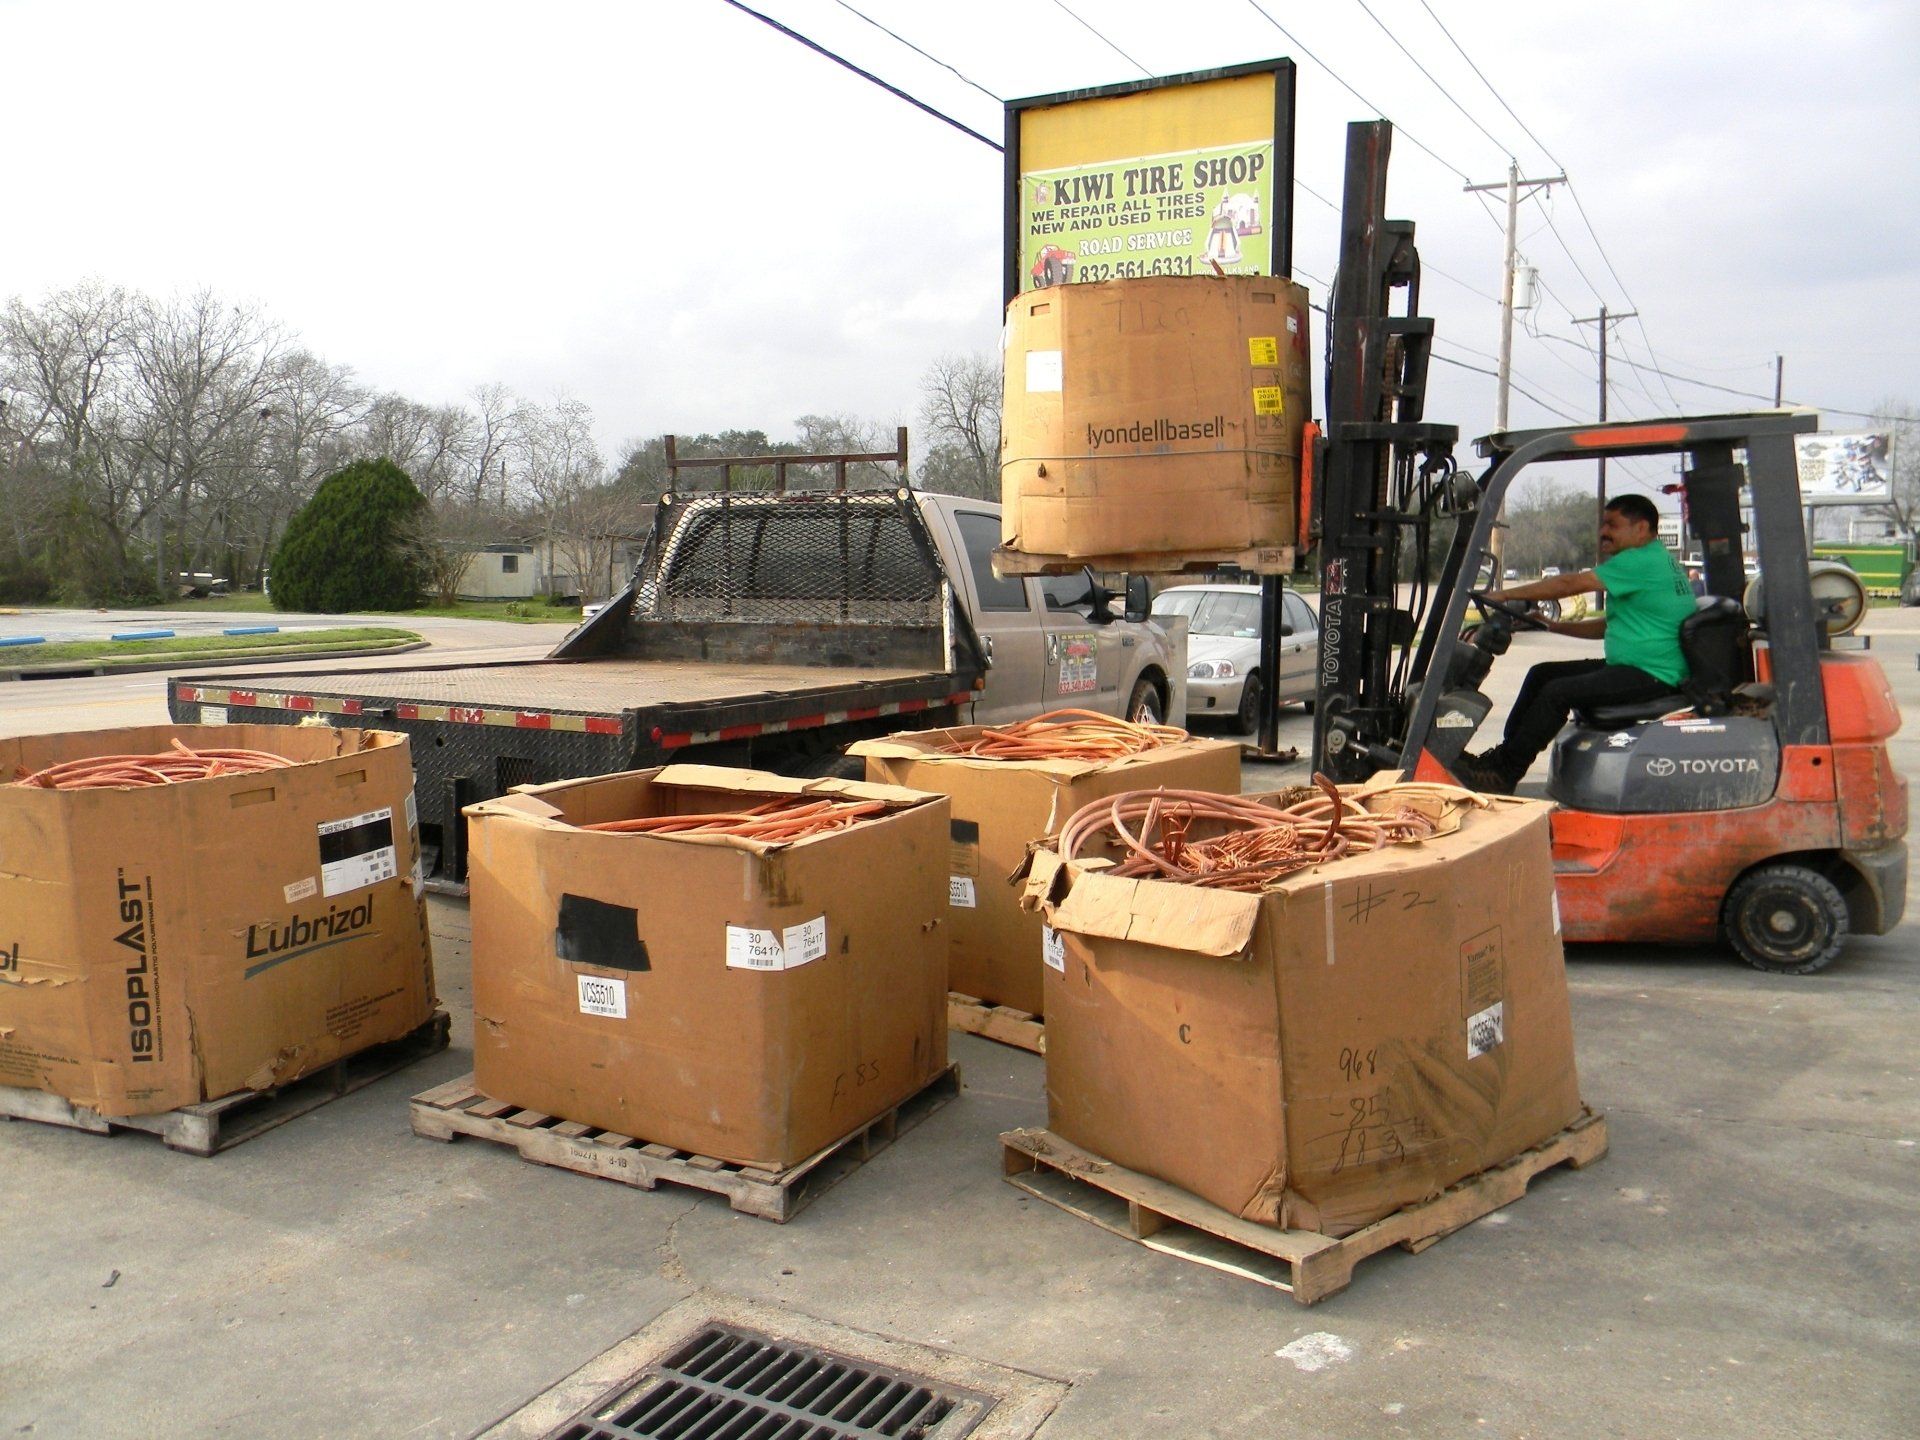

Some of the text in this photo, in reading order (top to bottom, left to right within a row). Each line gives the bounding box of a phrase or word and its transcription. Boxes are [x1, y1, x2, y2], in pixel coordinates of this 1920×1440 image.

[1053, 153, 1264, 206] KIWI TIRE SHOP
[1030, 205, 1205, 235] NEW AND USED TIRES
[1032, 192, 1205, 222] WE REPAIR ALL TIRES
[1079, 228, 1192, 256] ROAD SERVICE
[1079, 255, 1192, 283] 832-561-6331
[1087, 415, 1224, 450] lyondellbasell
[1322, 599, 1342, 687] TOYOTA
[1679, 758, 1760, 774] TOYOTA
[148, 902, 158, 955] POLYURETHANE
[246, 893, 373, 959] Lubrizol
[748, 933, 762, 944] 30
[802, 925, 812, 937] 30
[802, 932, 824, 949] 76417
[748, 945, 780, 956] 76417
[113, 878, 153, 1062] ISOPLAST
[152, 955, 162, 1013] THERMOPLASTIC
[581, 981, 615, 1006] VCS5510
[153, 1016, 164, 1062] ENGINEERING
[1178, 1023, 1191, 1045] C
[1339, 1047, 1377, 1082] 968
